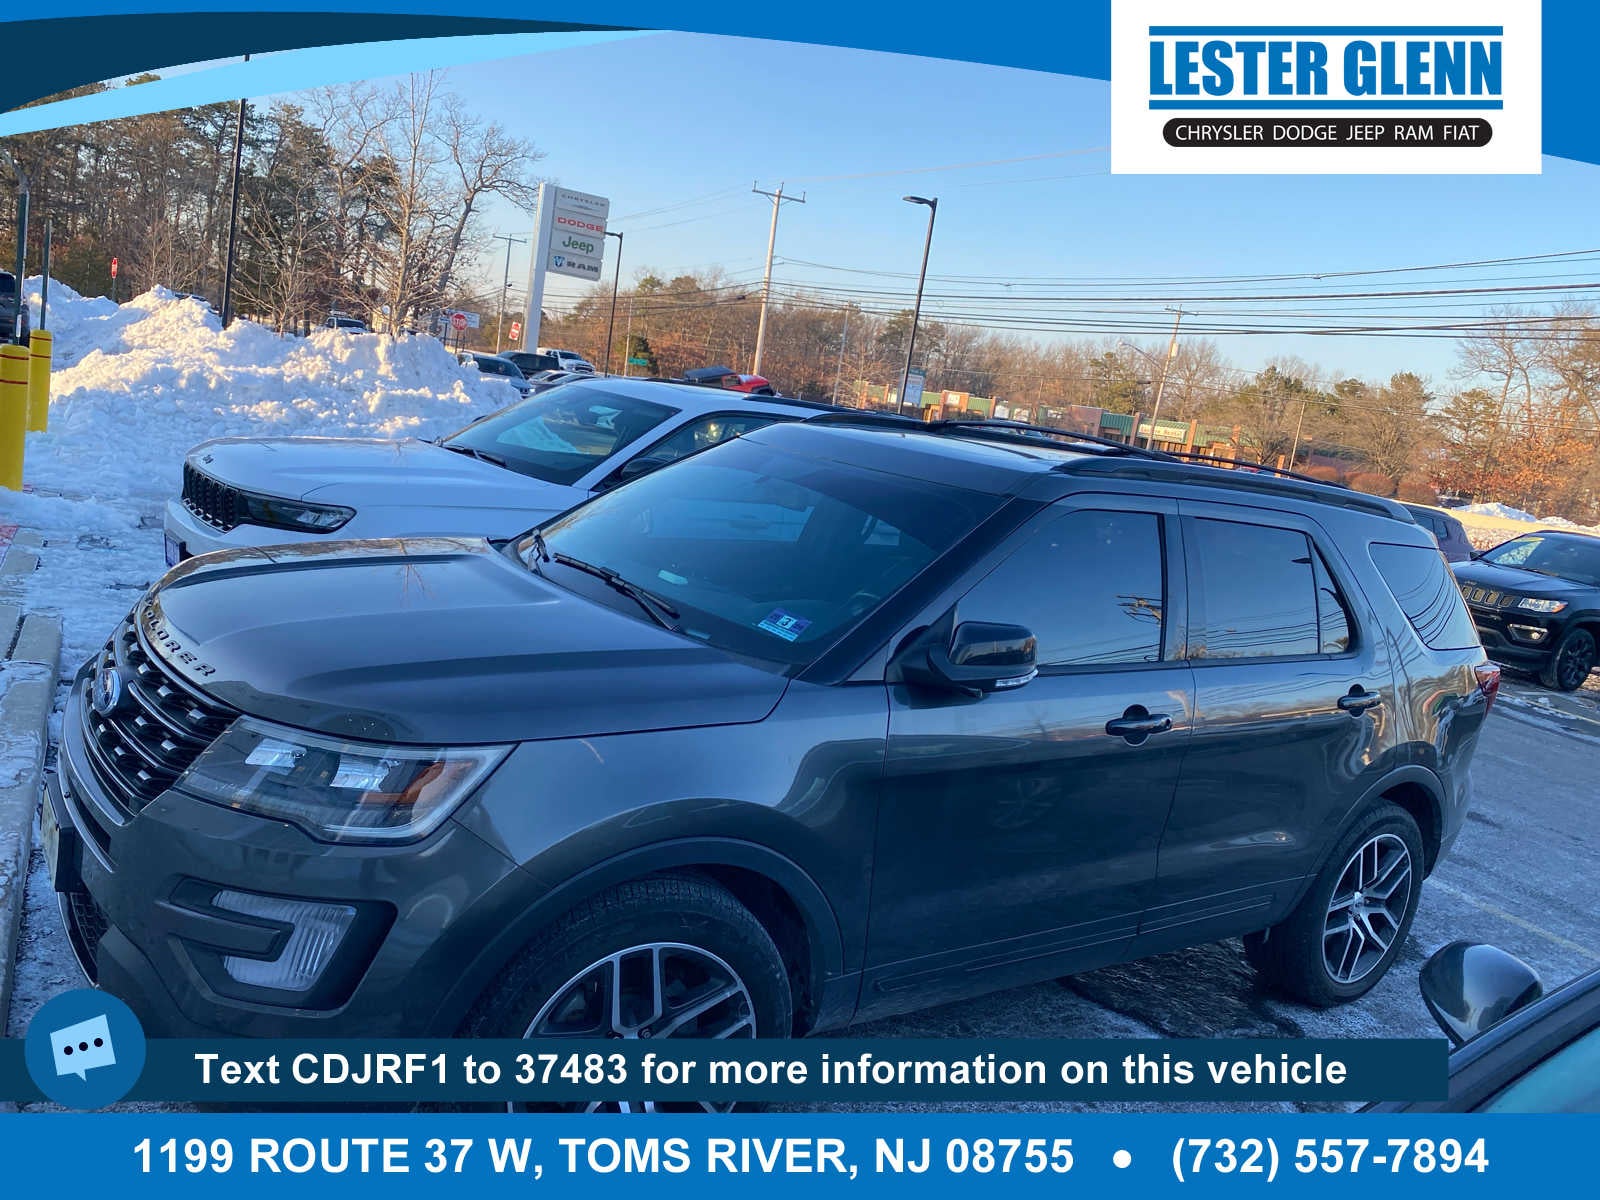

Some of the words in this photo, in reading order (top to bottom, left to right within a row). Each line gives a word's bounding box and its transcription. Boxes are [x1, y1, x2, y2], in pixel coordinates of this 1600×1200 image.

[557, 216, 604, 232] DODGE
[562, 236, 594, 254] Jeep
[566, 260, 599, 273] RAM
[452, 317, 467, 327] STOP
